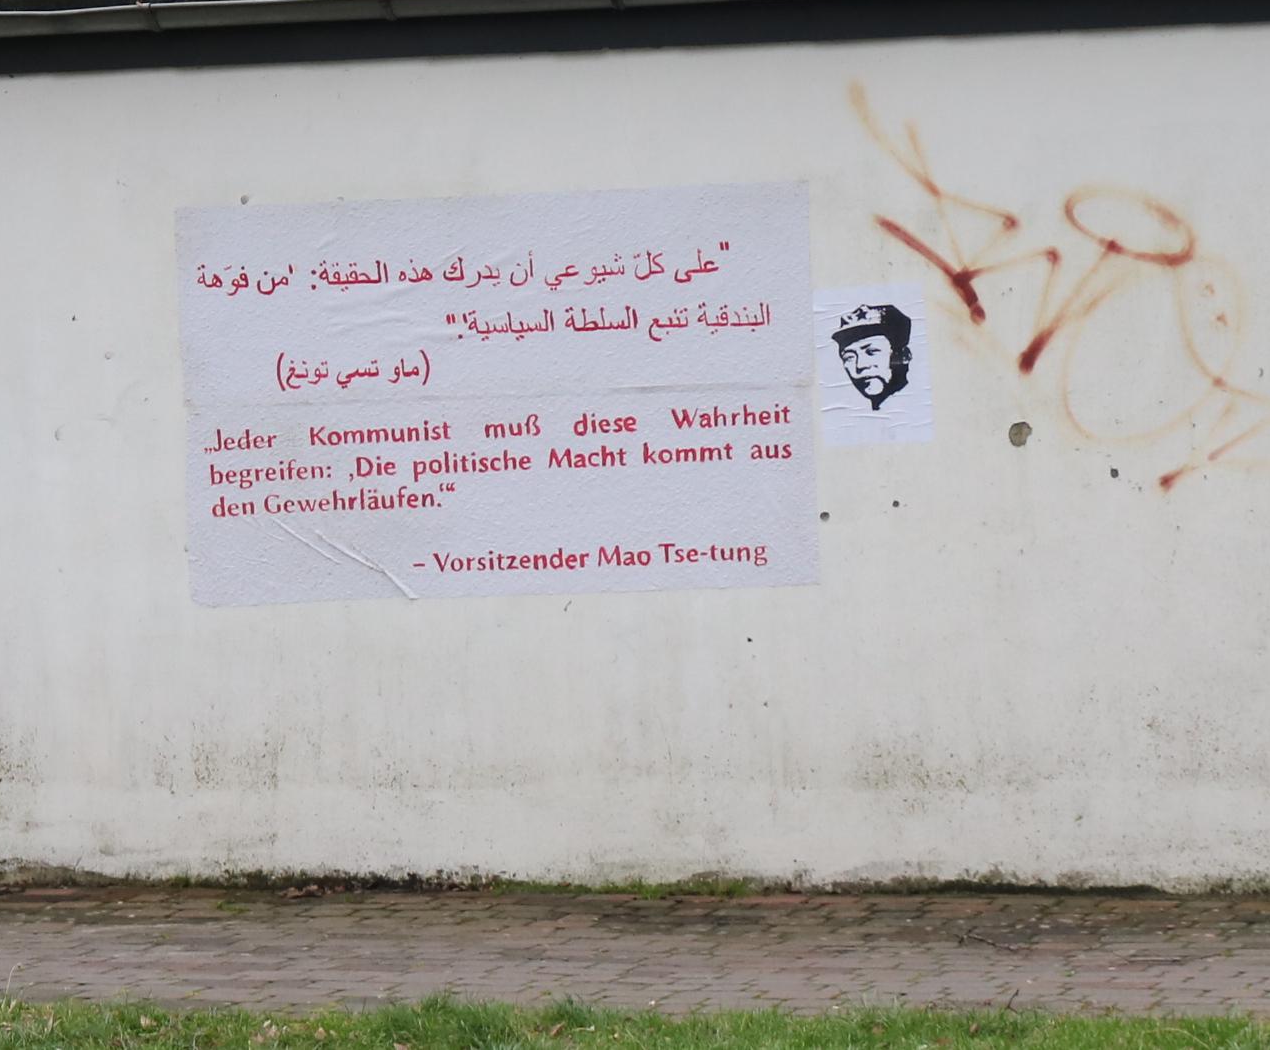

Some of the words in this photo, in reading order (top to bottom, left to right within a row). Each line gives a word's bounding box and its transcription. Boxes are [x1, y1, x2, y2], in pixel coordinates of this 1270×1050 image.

[310, 259, 390, 292] الحقيقة:
[398, 258, 434, 284] هذه
[442, 256, 501, 289] يدرك
[509, 250, 535, 287] أن
[544, 252, 626, 291] شيوعي
[564, 305, 639, 333] السلطة
[648, 306, 689, 343] تنبع
[696, 301, 771, 335] البندقية
[335, 359, 380, 390] تسي
[387, 349, 431, 386] (ماو
[308, 420, 452, 447] Kommunist
[484, 413, 542, 439] muß
[573, 412, 638, 437] diese
[670, 403, 791, 430] Wahrheit
[209, 459, 333, 490] begreifen:
[412, 450, 533, 483] politische
[547, 444, 627, 469] Macht
[642, 441, 734, 465] kommt
[749, 442, 793, 461] aus
[211, 495, 256, 518] den
[432, 547, 590, 573] Vorsitzender
[597, 545, 652, 568] Mao
[658, 542, 768, 568] Tse-tung
